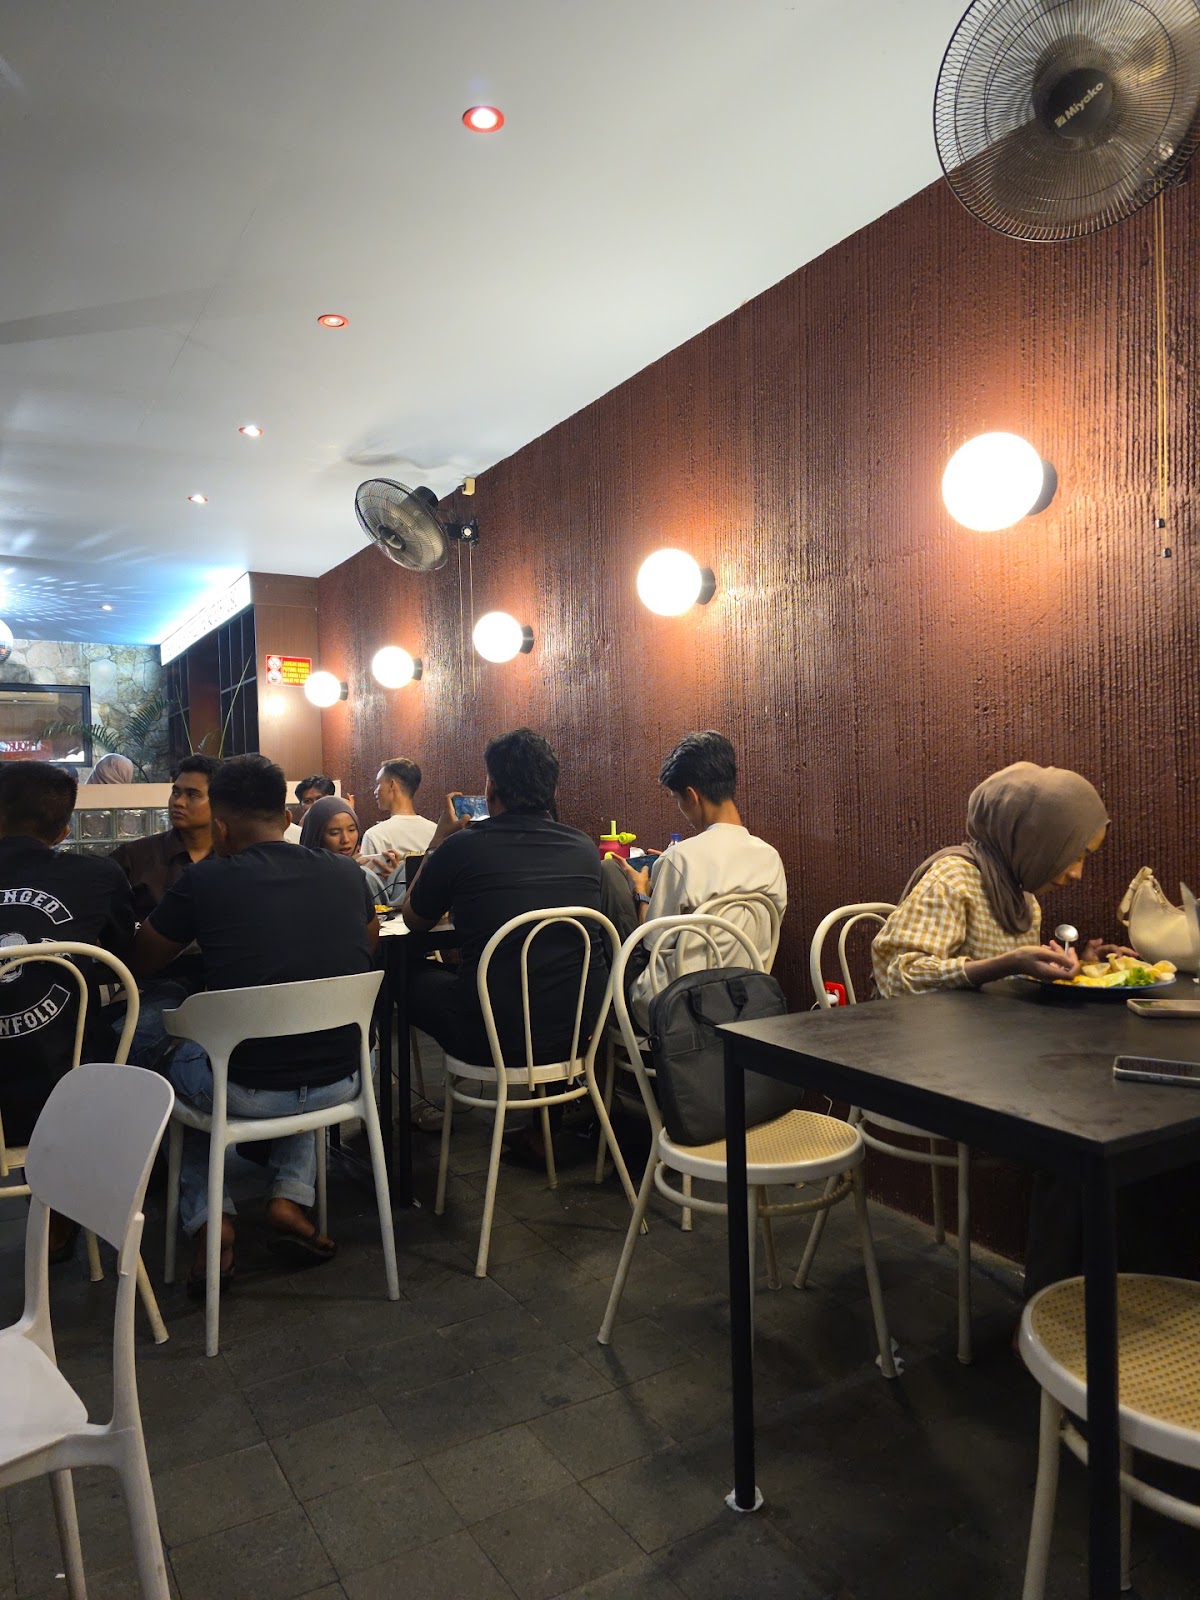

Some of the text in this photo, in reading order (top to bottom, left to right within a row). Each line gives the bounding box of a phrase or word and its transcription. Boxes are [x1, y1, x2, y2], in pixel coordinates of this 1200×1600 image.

[1065, 83, 1103, 119] Miyako
[3, 890, 60, 914] NGED
[0, 999, 59, 1036] NFOLD
